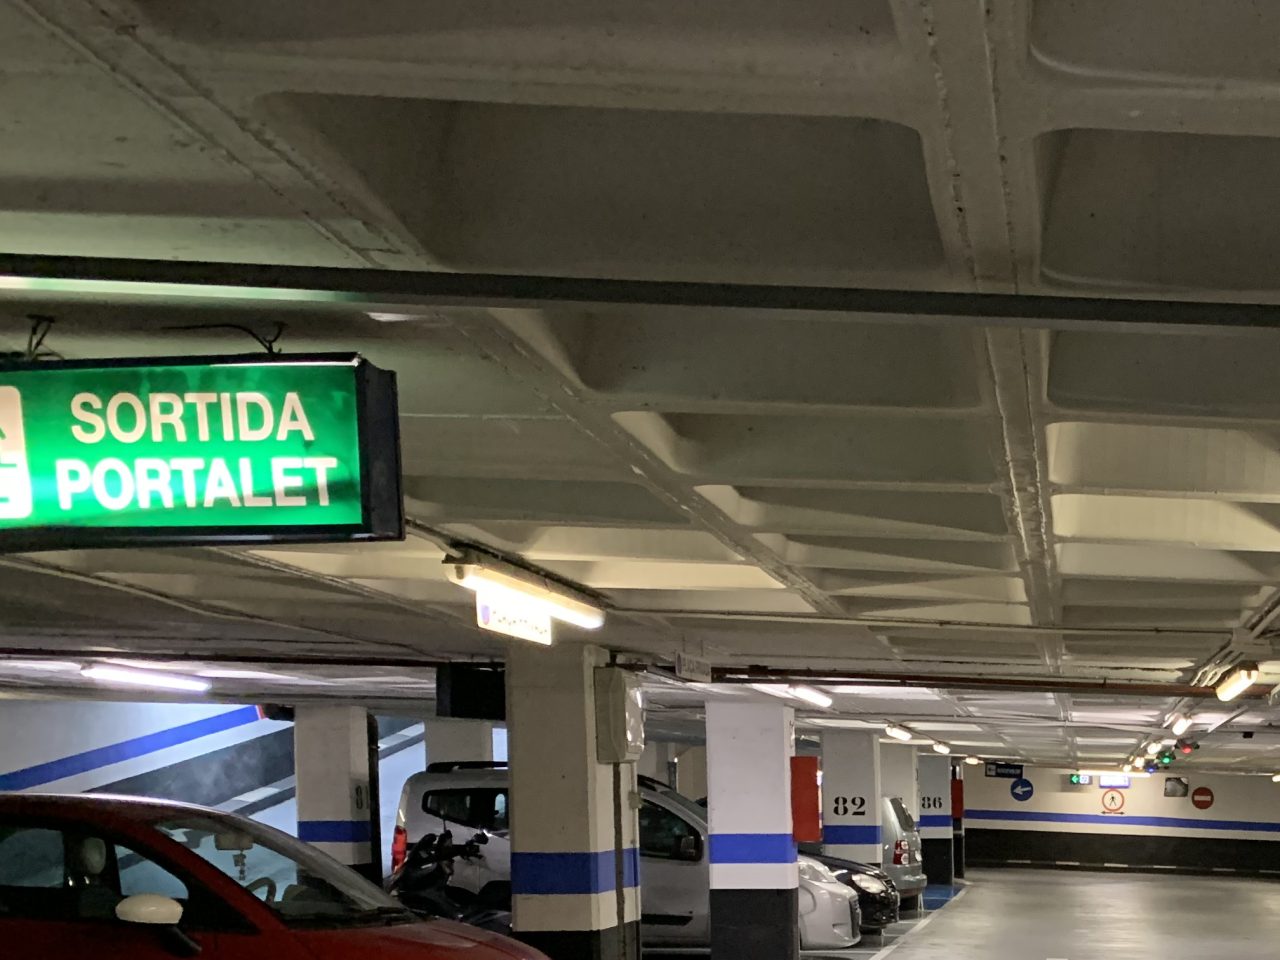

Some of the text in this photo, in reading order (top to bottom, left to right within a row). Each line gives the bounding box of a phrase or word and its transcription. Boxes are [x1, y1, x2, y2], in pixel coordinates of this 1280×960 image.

[70, 391, 315, 444] SORTIDA
[54, 456, 339, 511] PORTALET
[833, 796, 866, 816] 82
[921, 796, 943, 809] 86
